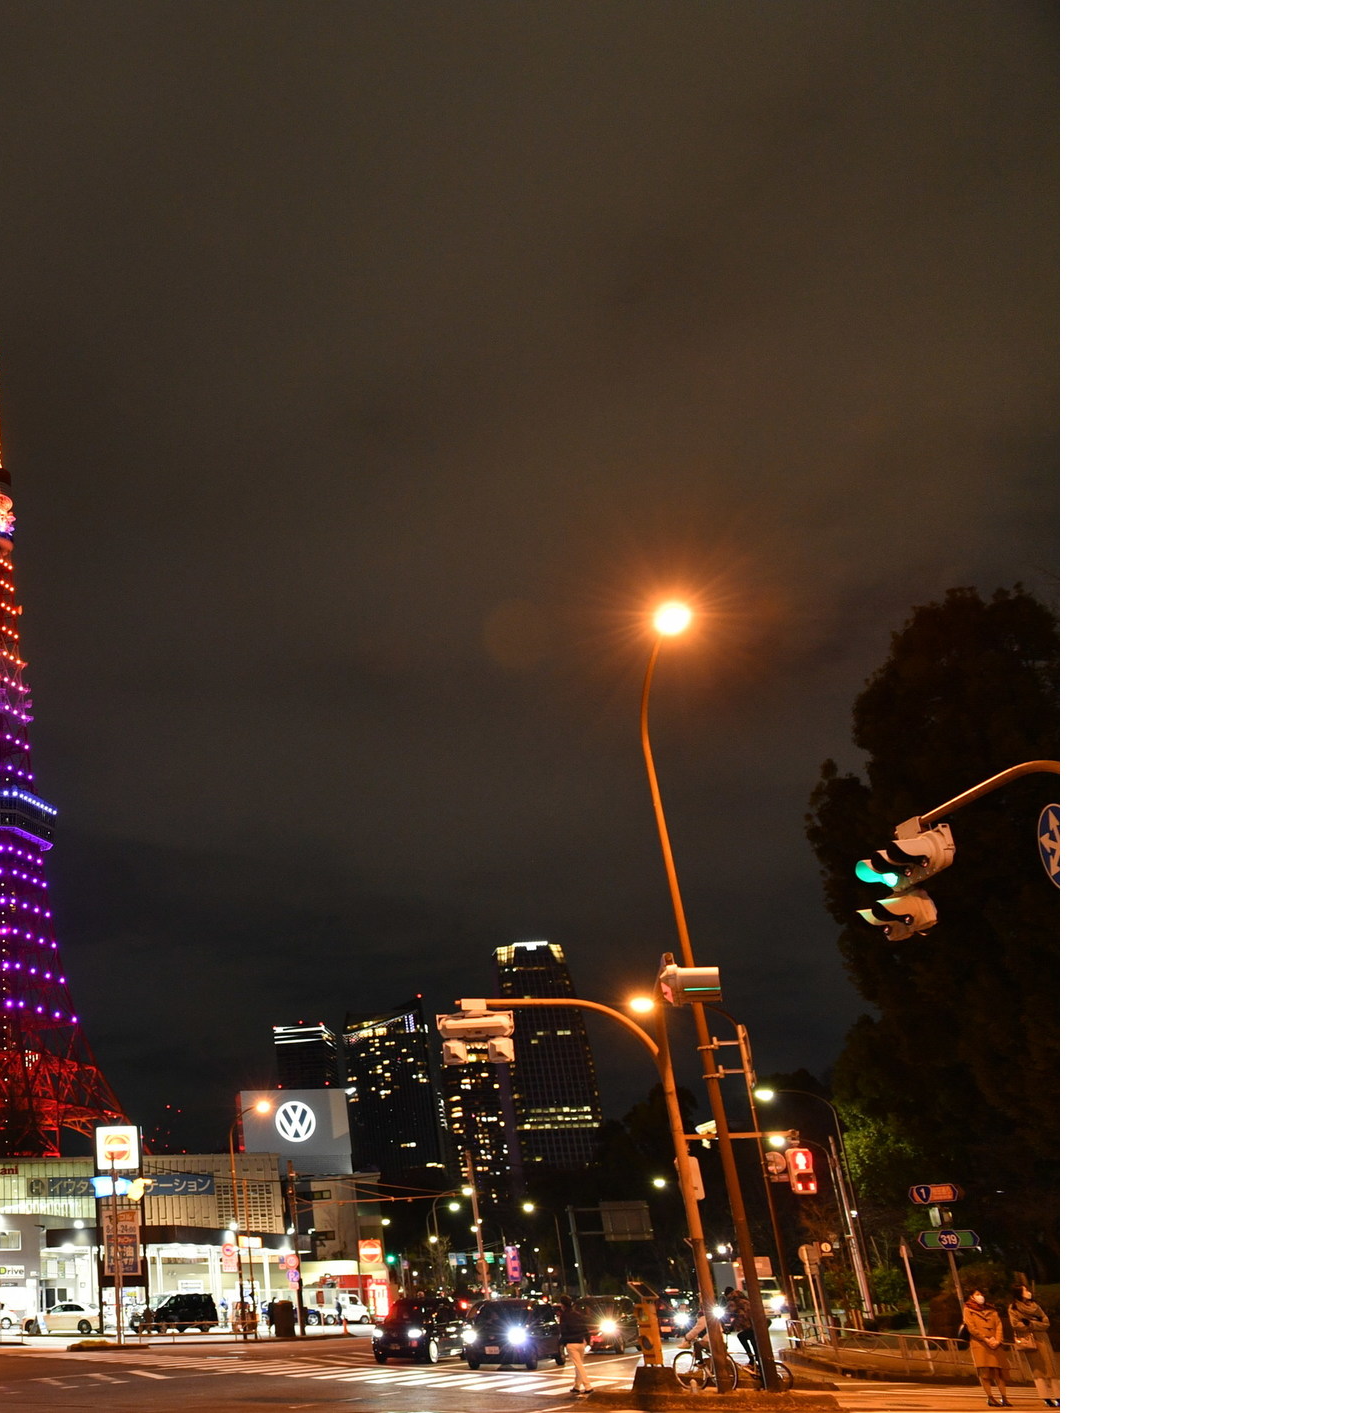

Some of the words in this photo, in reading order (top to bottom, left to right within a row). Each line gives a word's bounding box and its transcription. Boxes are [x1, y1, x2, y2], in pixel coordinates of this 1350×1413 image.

[52, 1178, 211, 1195] イワタテーション
[919, 1188, 926, 1199] 1
[940, 1234, 958, 1245] 319
[0, 1267, 25, 1275] Drive
